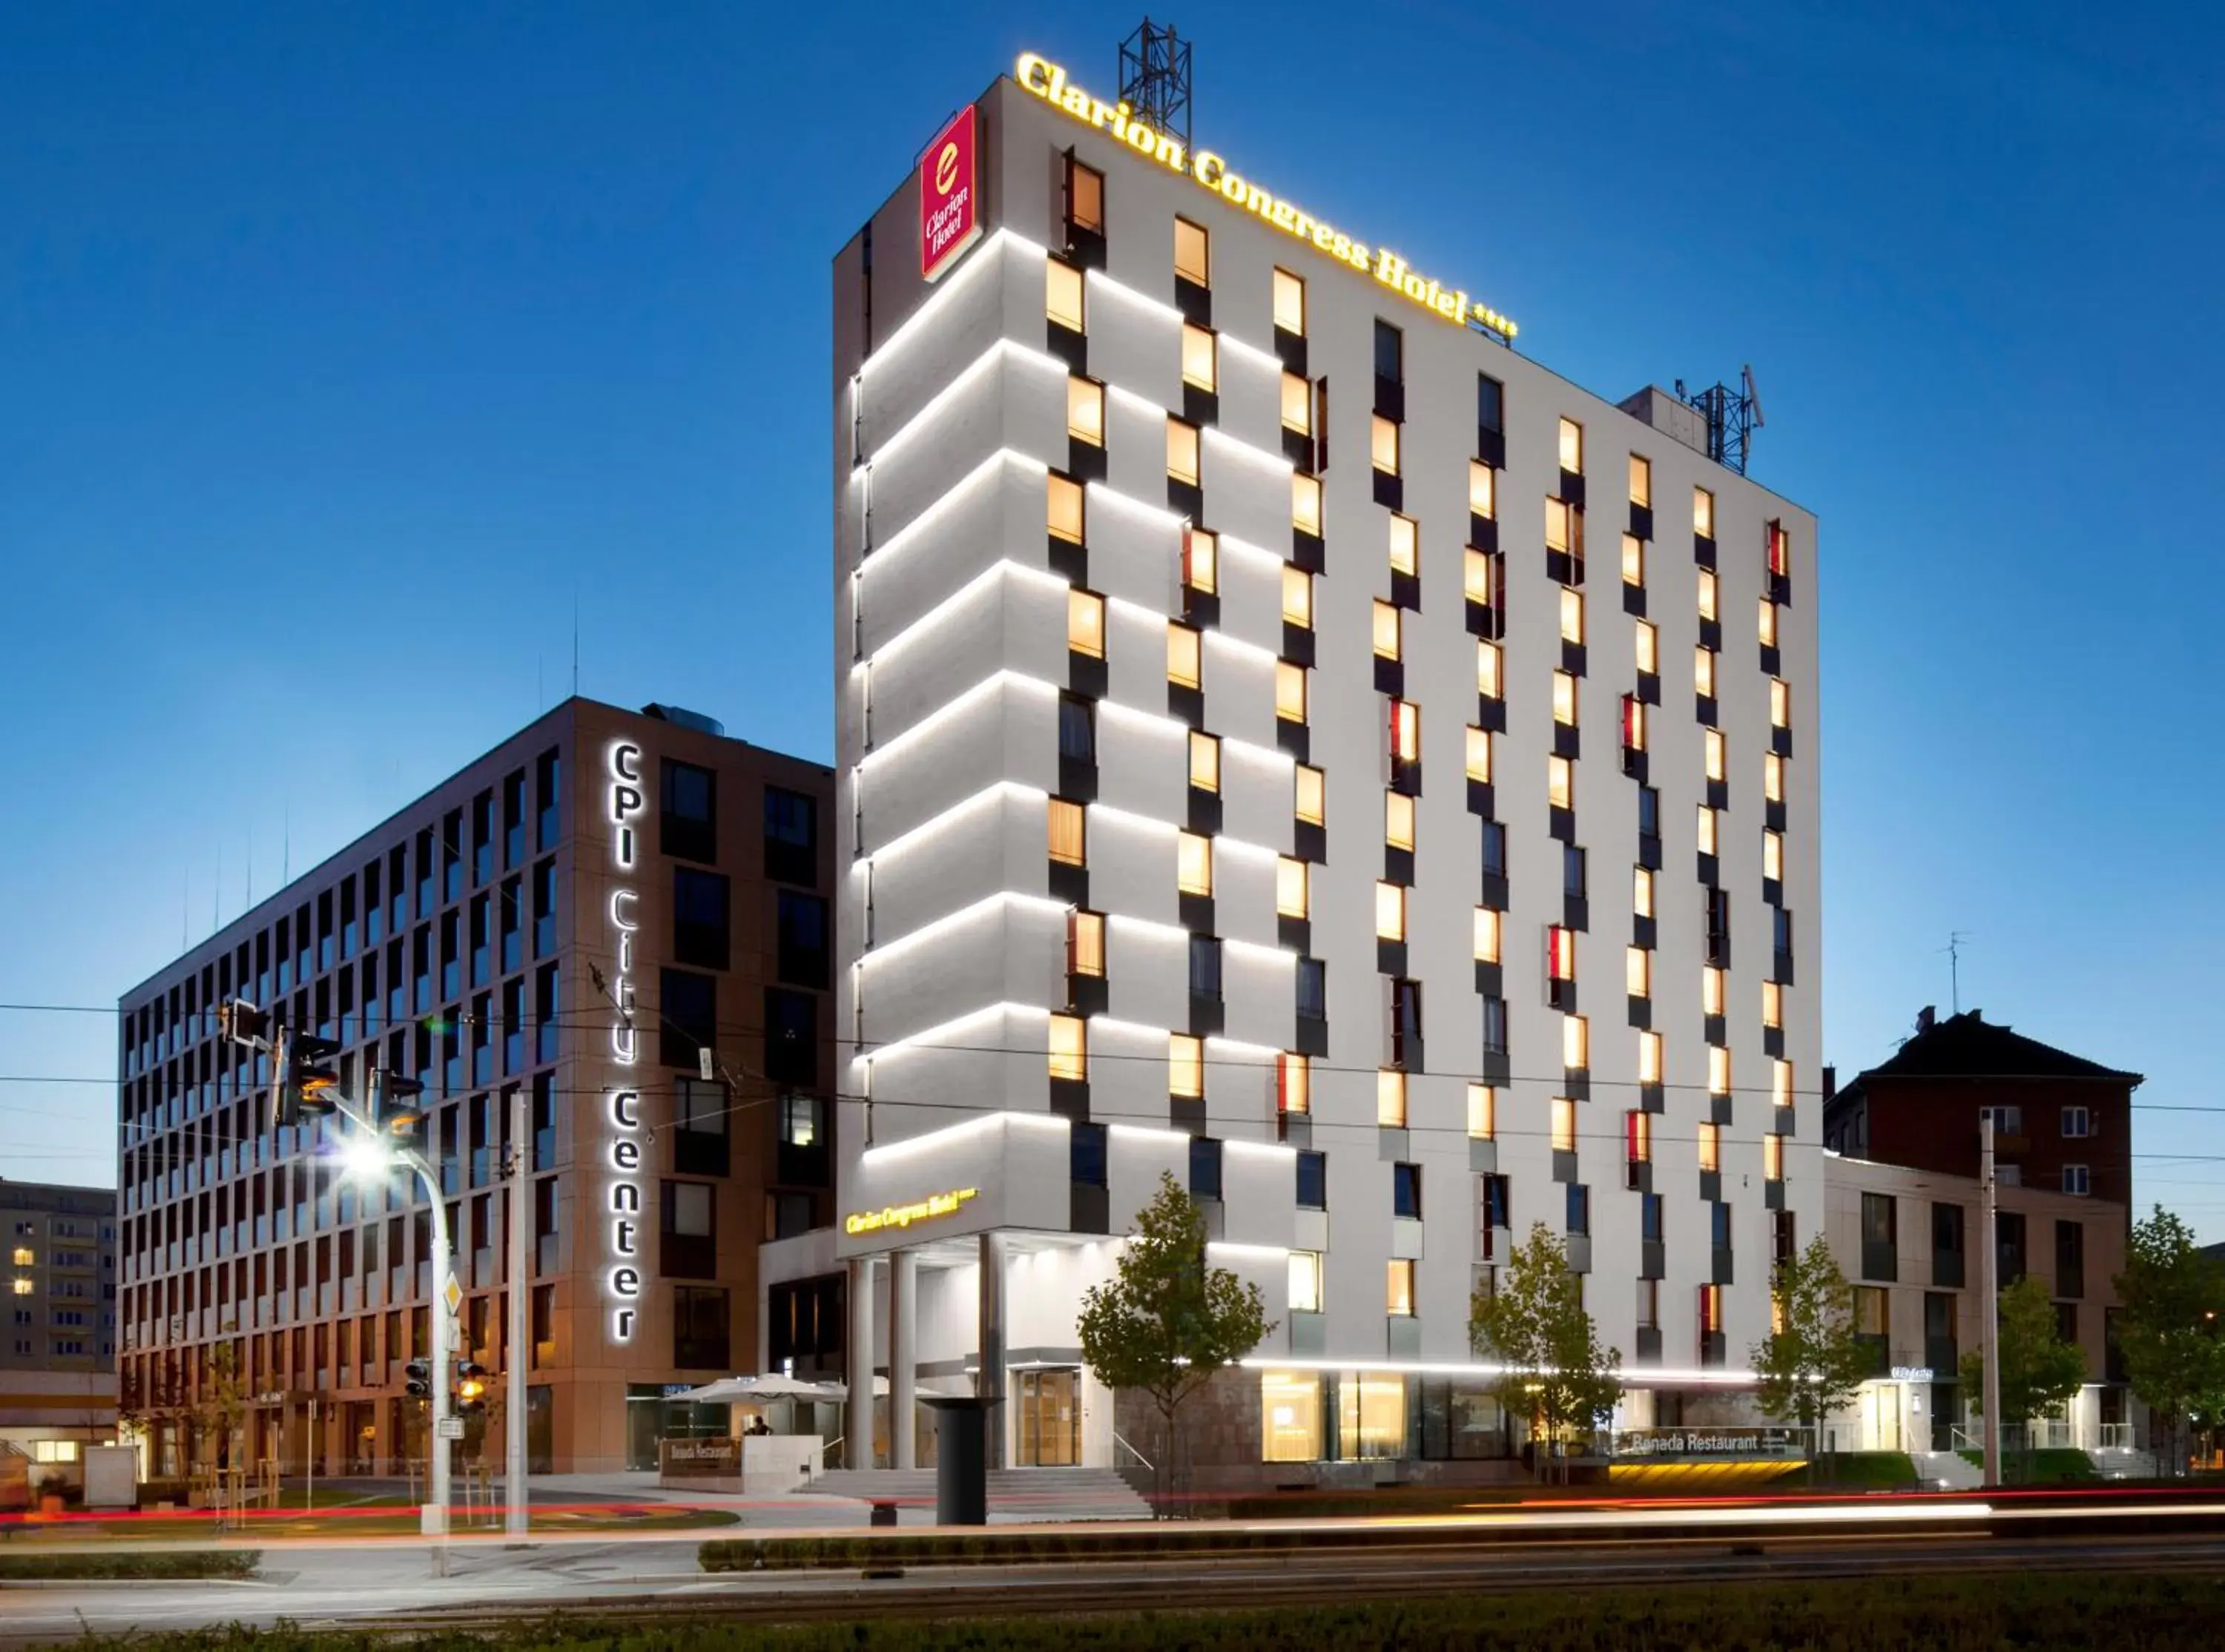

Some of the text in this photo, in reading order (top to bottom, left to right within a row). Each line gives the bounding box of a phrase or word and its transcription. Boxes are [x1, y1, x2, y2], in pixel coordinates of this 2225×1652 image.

[926, 186, 968, 239] Clarion
[1017, 52, 1468, 326] Clarion Congress Hotel
[932, 208, 962, 255] Hotel
[610, 740, 643, 1341] CPI City Center
[1688, 1434, 1758, 1451] Restaurant
